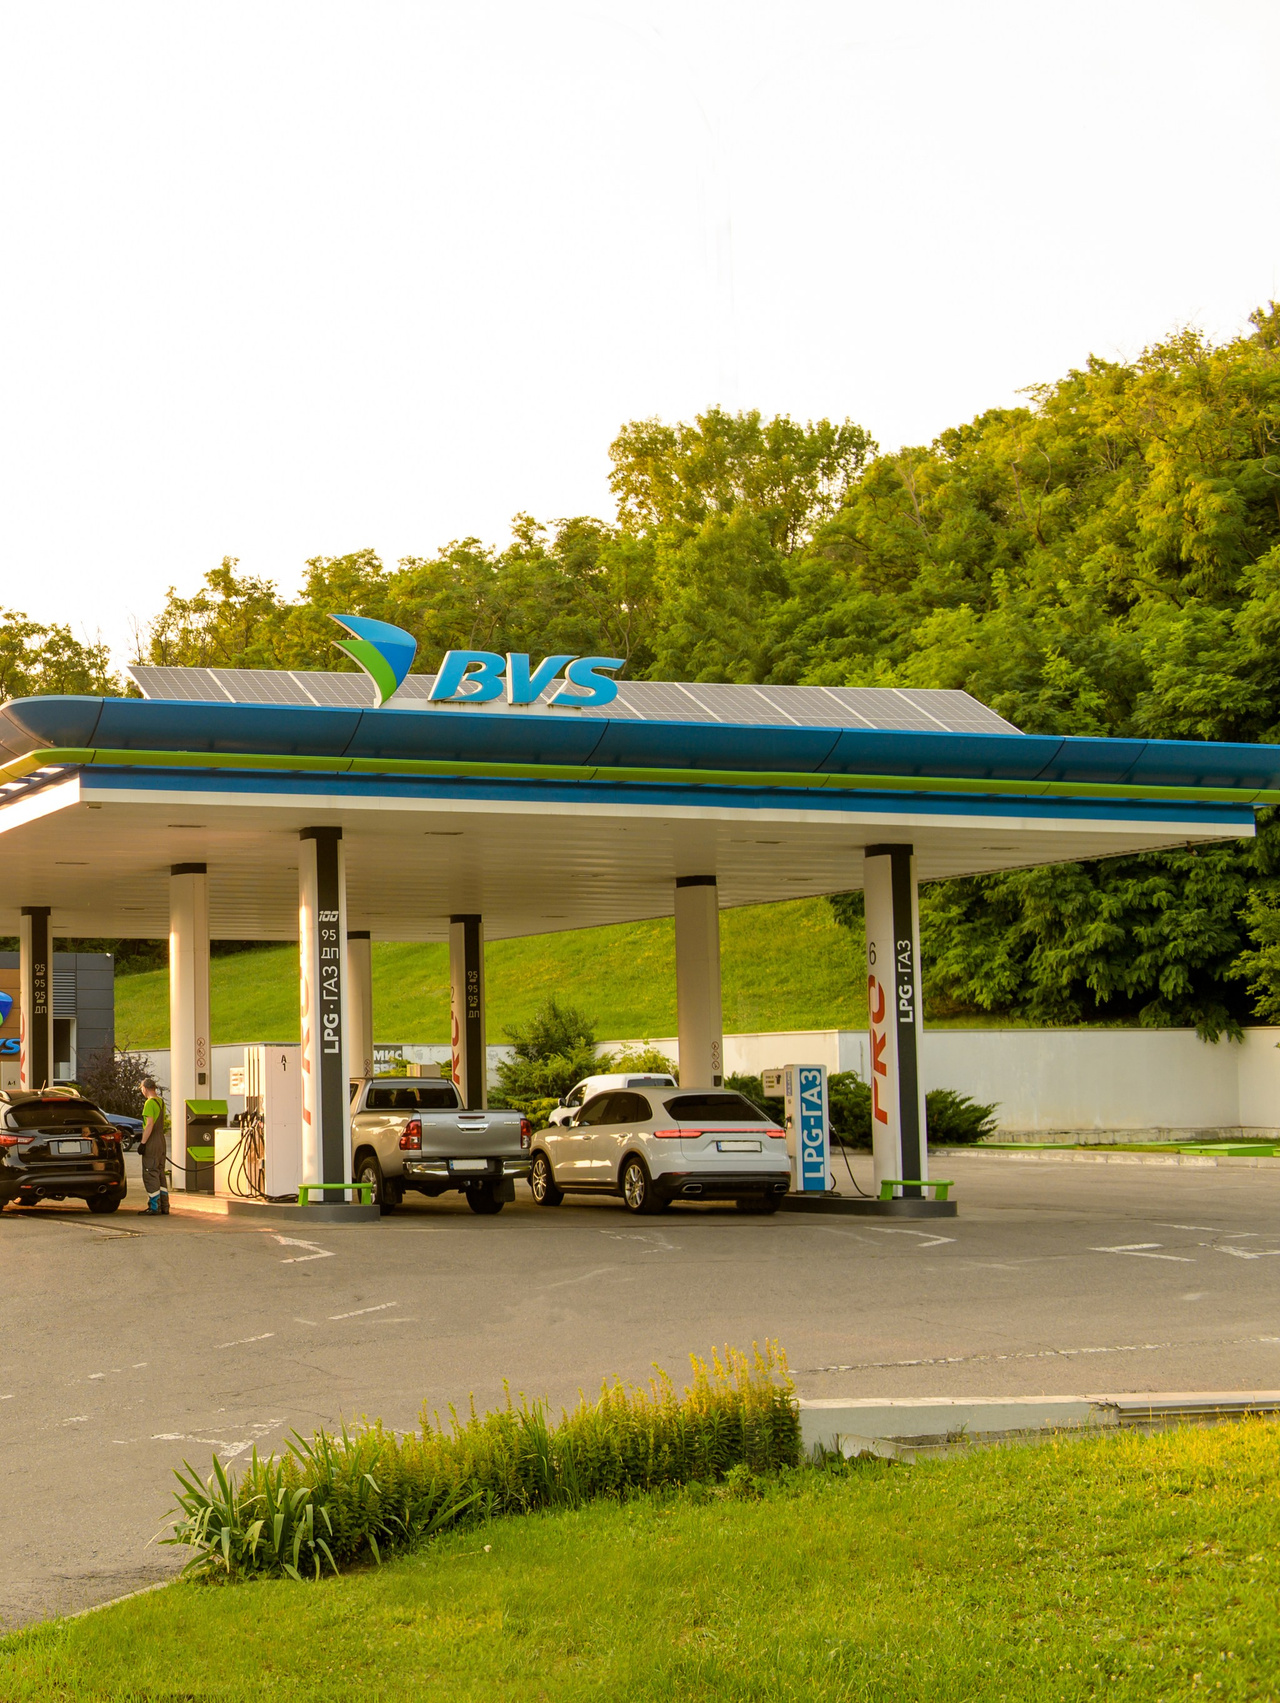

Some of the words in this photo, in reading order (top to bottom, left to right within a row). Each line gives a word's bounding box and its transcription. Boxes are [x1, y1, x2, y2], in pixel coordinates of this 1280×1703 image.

[427, 650, 626, 707] BVS
[319, 910, 339, 922] 100
[321, 929, 337, 941] 95
[321, 947, 339, 959] ДП
[869, 941, 876, 965] 6
[897, 939, 911, 973] ГАЗ
[34, 964, 45, 972] 95
[467, 971, 478, 979] 95
[34, 979, 45, 987] 95
[322, 965, 338, 1000] ГАЗ
[34, 991, 46, 999] 95
[467, 985, 478, 993] 95
[899, 985, 913, 1023] LPG
[323, 1013, 339, 1054] LPG
[800, 1070, 824, 1178] LPG-ГАЗ
